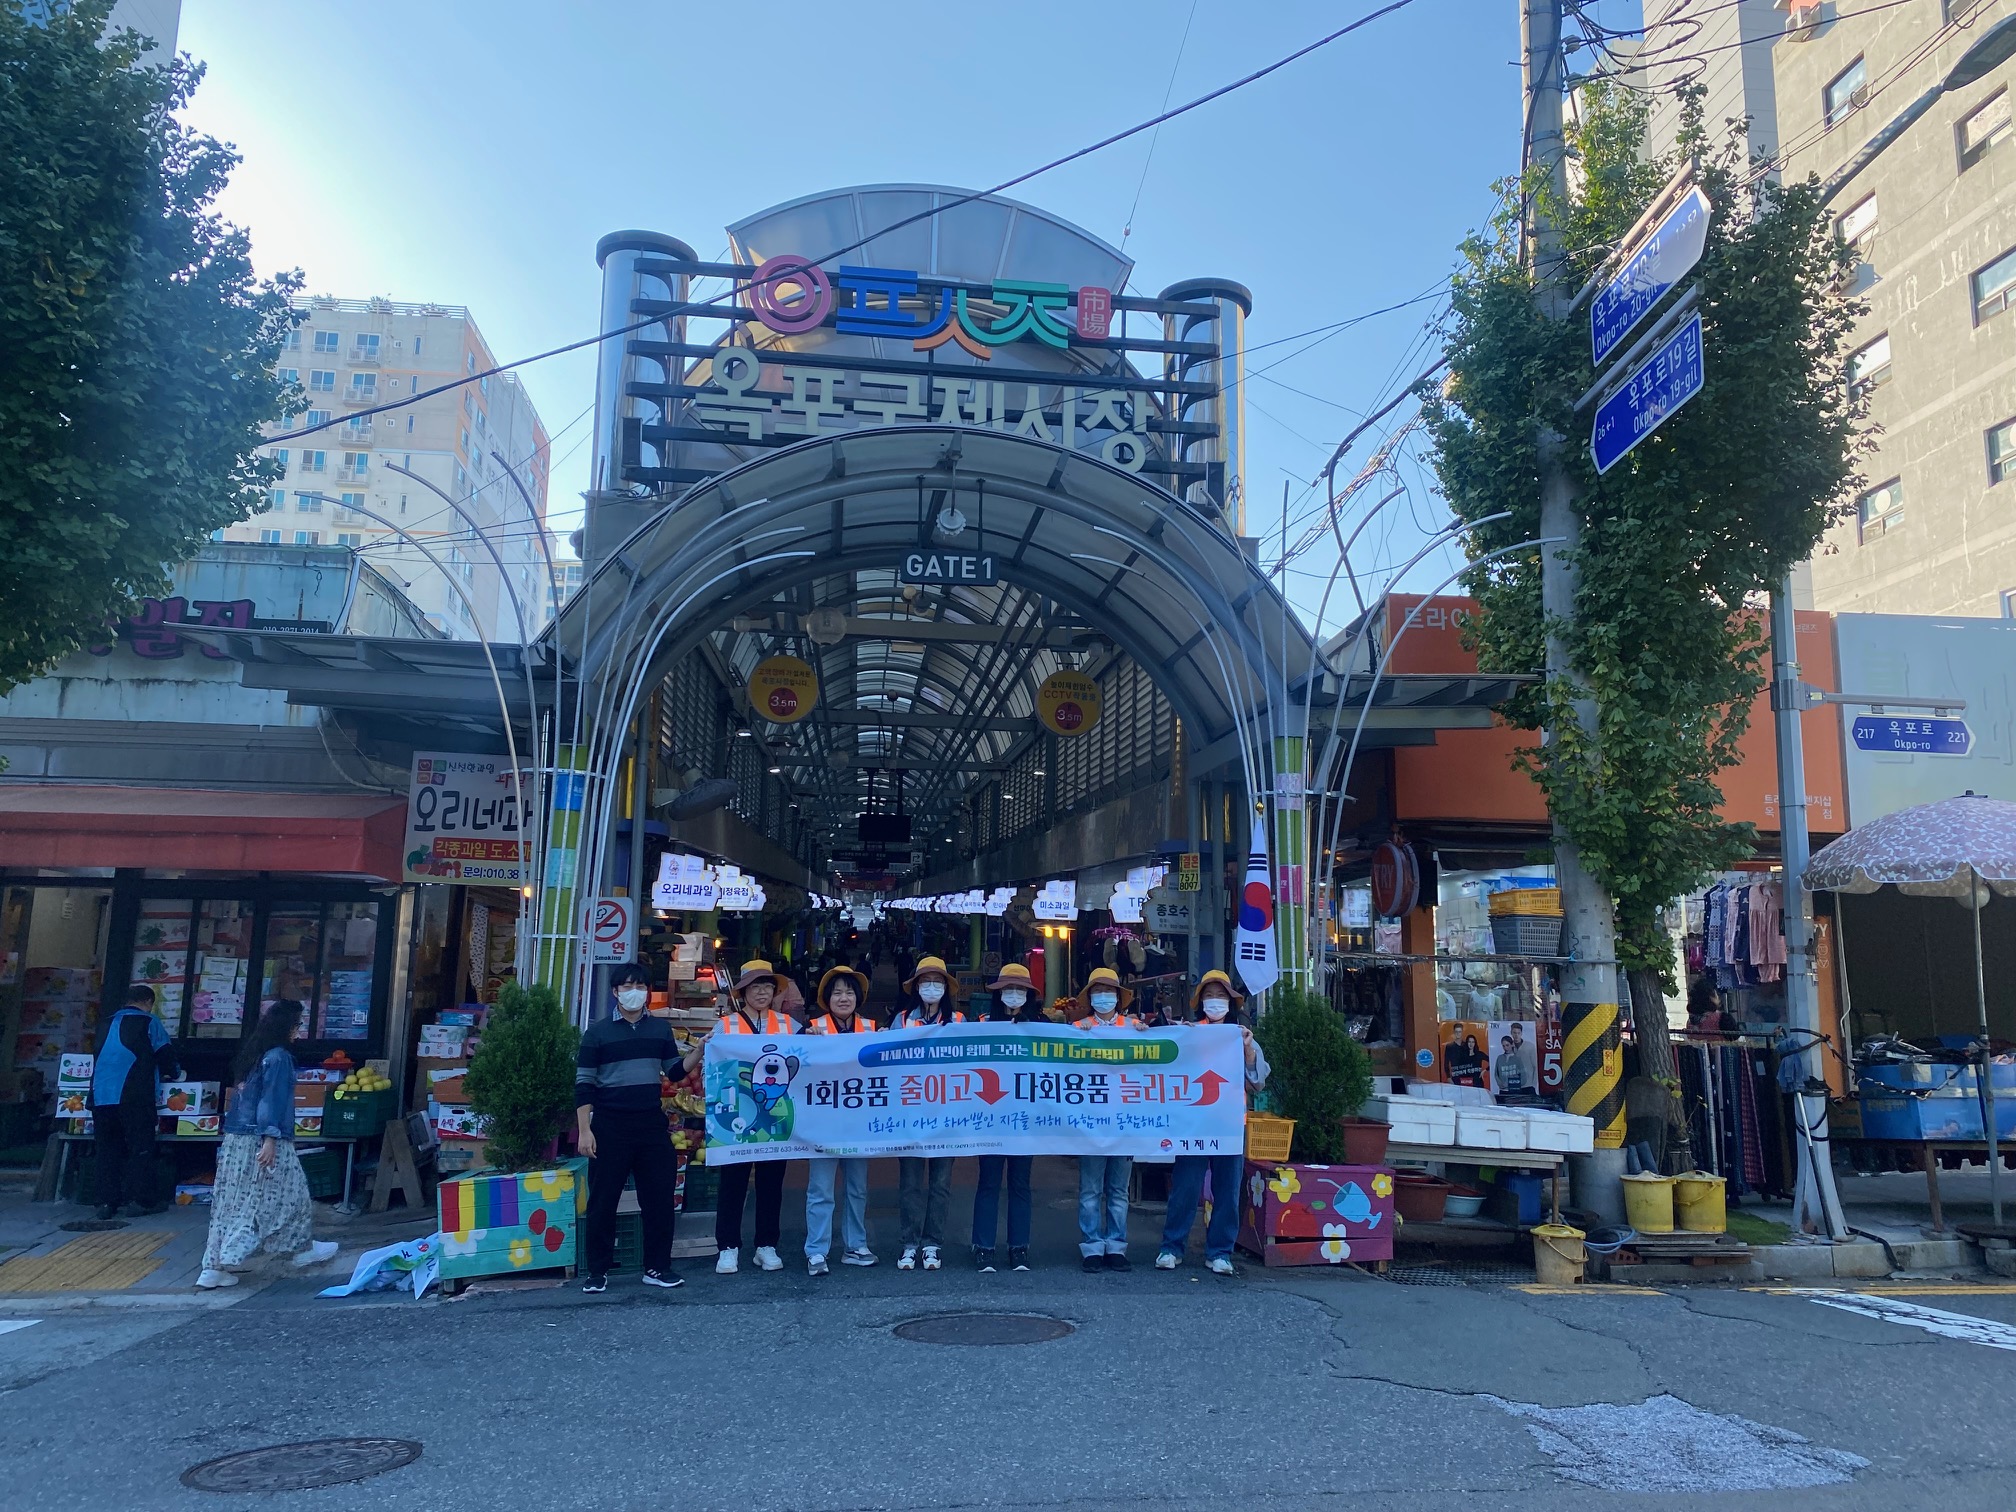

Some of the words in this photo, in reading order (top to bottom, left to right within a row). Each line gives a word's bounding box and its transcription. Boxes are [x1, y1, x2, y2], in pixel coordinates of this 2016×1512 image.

[1595, 237, 1662, 327] 옥포로20길
[1597, 313, 1628, 354] Okpo-ro
[1629, 326, 1697, 410] 옥포로19길
[1633, 397, 1667, 434] Okpo-ro
[1670, 363, 1699, 403] 19-gil
[696, 347, 1153, 472] 옥포국제시장
[1597, 426, 1607, 441] 26
[906, 556, 974, 578] GATE
[770, 695, 796, 707] 3.5m
[1057, 709, 1081, 721] 3.5m
[1858, 728, 1874, 739] 217
[1889, 721, 1934, 736] 옥포로
[1895, 739, 1930, 750] Okpo-ro
[1948, 732, 1965, 743] 221
[436, 841, 486, 858] 각종과일
[1183, 855, 1199, 869] 결혼
[1180, 873, 1199, 882] 7571
[1374, 863, 1395, 889] TRY
[661, 883, 713, 897] 오리네과일
[1179, 881, 1198, 891] 8097
[1040, 901, 1070, 910] 미소과일
[878, 1048, 925, 1063] 거제시와
[928, 1045, 963, 1058] 시민이
[966, 1044, 991, 1057] 함께
[993, 1044, 1029, 1057] 그리는
[1032, 1041, 1065, 1058] 내가
[1068, 1043, 1124, 1060] Green
[1129, 1045, 1160, 1060] 거제
[805, 1075, 891, 1109] 1회용품
[900, 1074, 972, 1106] 줄이고
[1014, 1072, 1109, 1105] 다회용품
[1120, 1073, 1192, 1106] 늘리고
[867, 1117, 906, 1133] 1회용이
[912, 1115, 939, 1131] 아닌
[943, 1112, 995, 1131] 하나뿐인
[999, 1112, 1030, 1131] 지구를
[1035, 1113, 1062, 1128] 위해
[1067, 1113, 1112, 1130] 다함께
[1116, 1112, 1171, 1131] 동참해요!
[780, 1145, 809, 1154] 633-8646
[1180, 1139, 1219, 1151] 거제시
